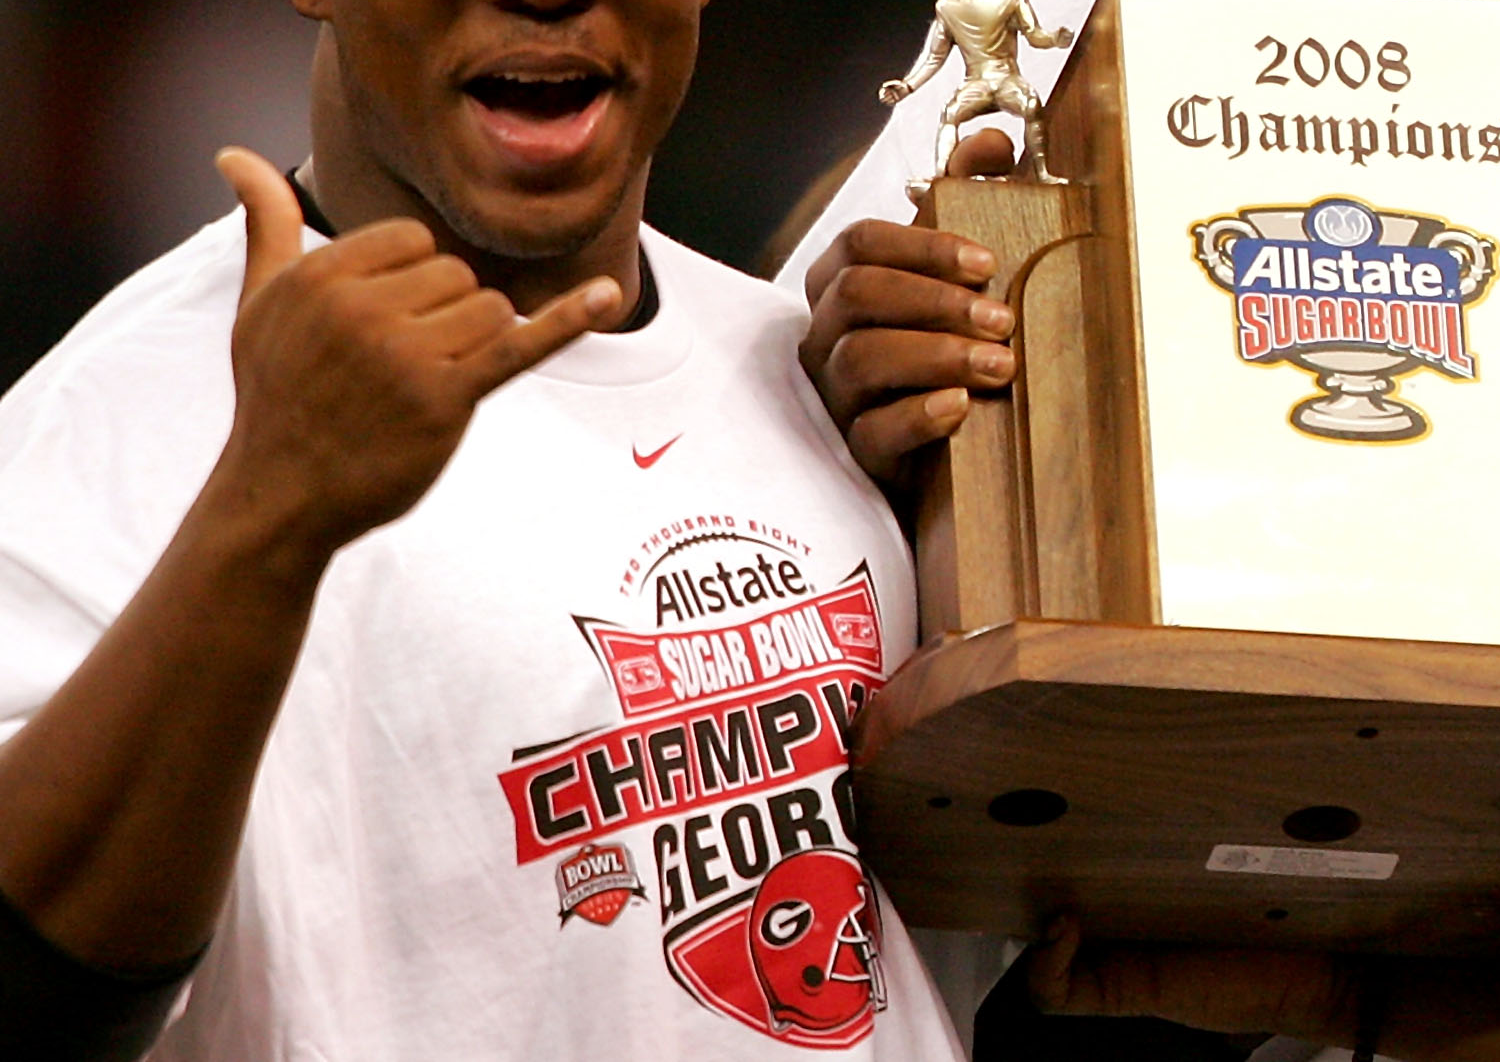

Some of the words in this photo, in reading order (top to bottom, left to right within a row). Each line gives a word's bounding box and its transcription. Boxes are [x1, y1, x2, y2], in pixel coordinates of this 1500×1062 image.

[1254, 35, 1412, 93] 2008
[1240, 245, 1443, 297] Allstate
[619, 558, 641, 597] TWO
[641, 514, 736, 555] THOUSAND
[748, 519, 813, 557] EIGHT
[656, 553, 808, 628] Allstate
[657, 629, 755, 701] SUGAR
[749, 604, 844, 679] BOWL
[564, 851, 624, 889] BOWL
